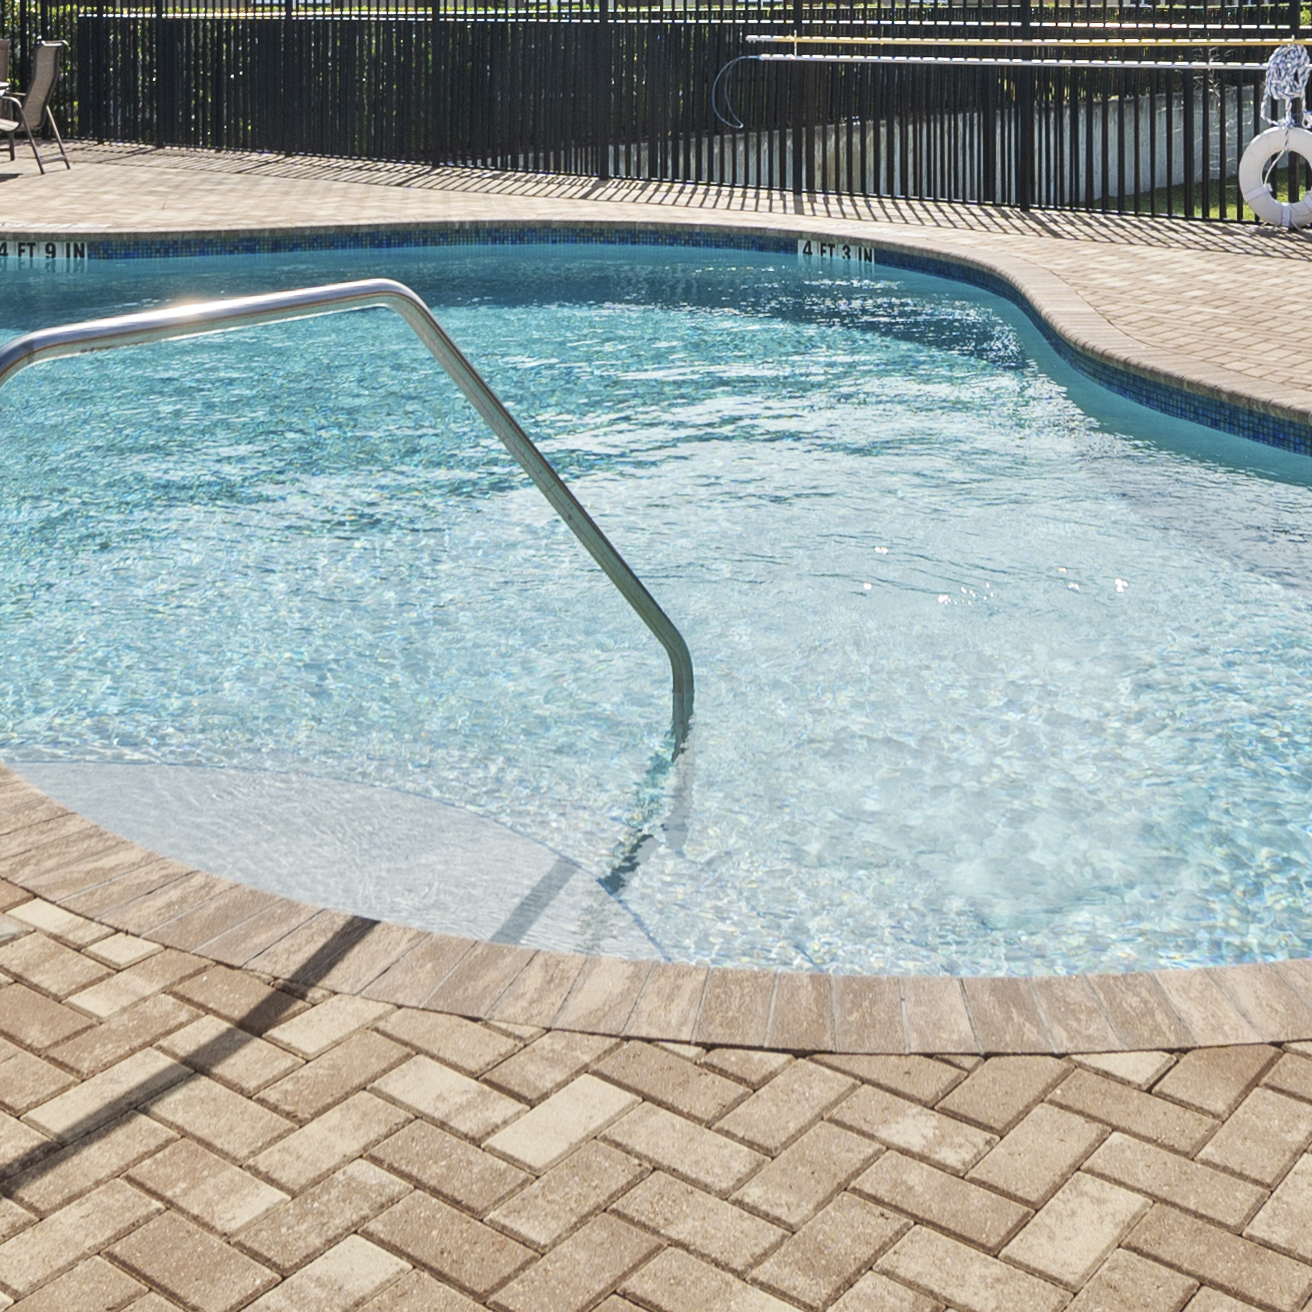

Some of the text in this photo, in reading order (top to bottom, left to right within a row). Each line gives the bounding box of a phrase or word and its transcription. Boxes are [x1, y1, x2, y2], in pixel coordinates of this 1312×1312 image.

[17, 242, 36, 258] FT
[45, 242, 57, 259] 9
[66, 242, 85, 259] IN
[802, 240, 873, 263] 4 FT 3 IN
